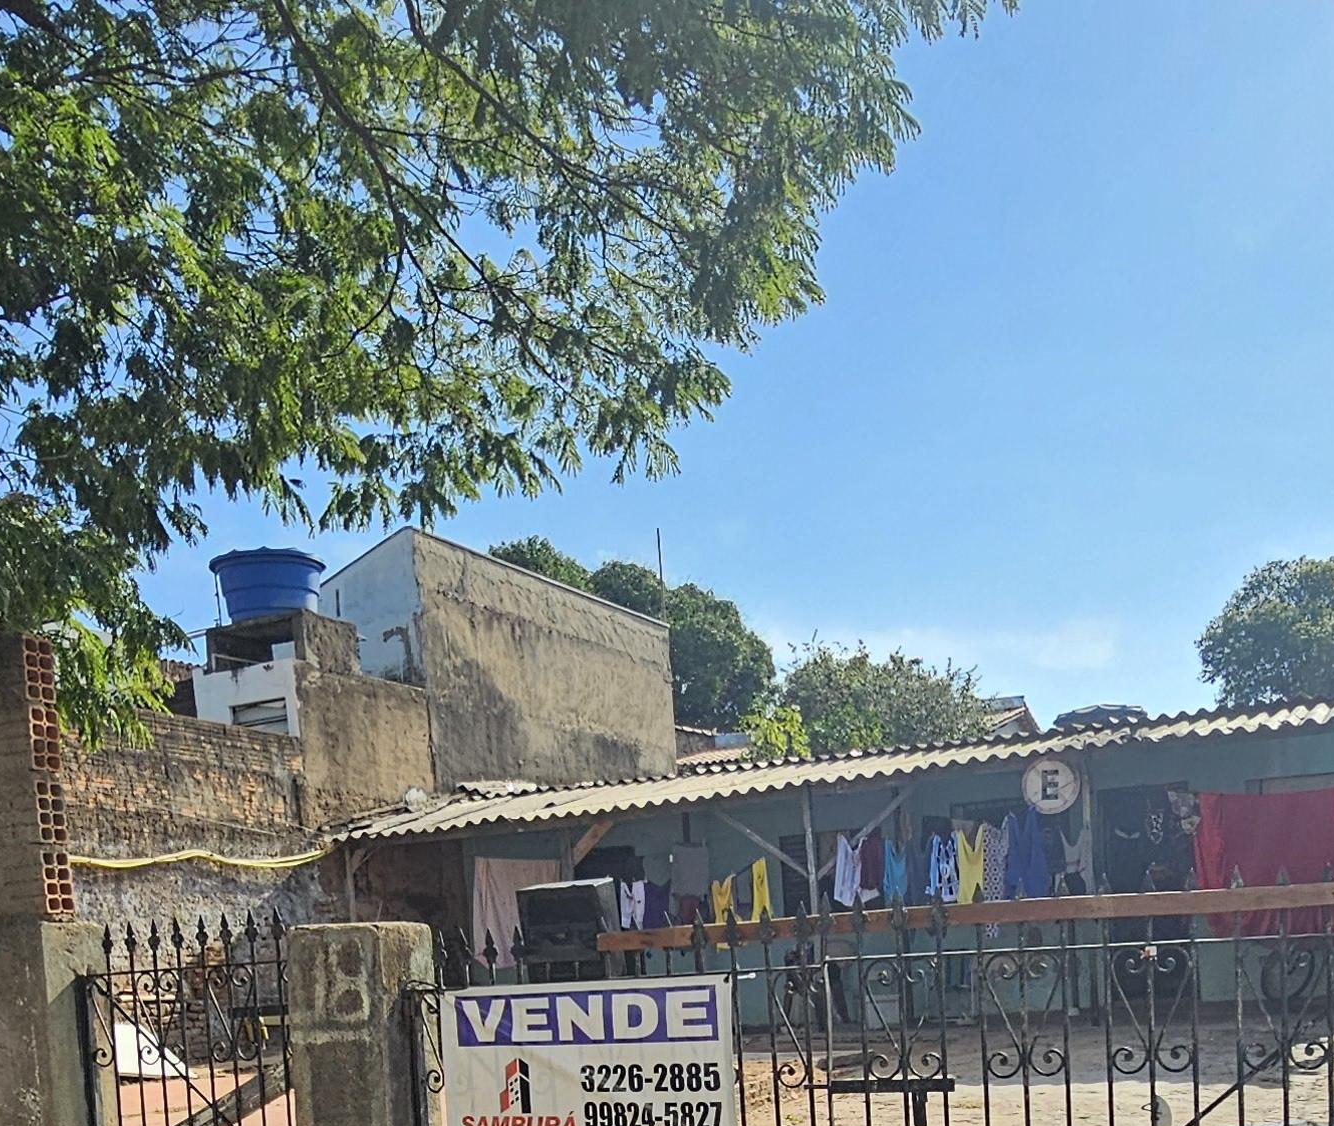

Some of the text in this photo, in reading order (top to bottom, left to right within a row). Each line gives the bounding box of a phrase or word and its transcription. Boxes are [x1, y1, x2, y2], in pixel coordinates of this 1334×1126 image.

[1040, 769, 1060, 801] E
[461, 989, 714, 1043] VENDE
[580, 1062, 722, 1093] 3226-2885
